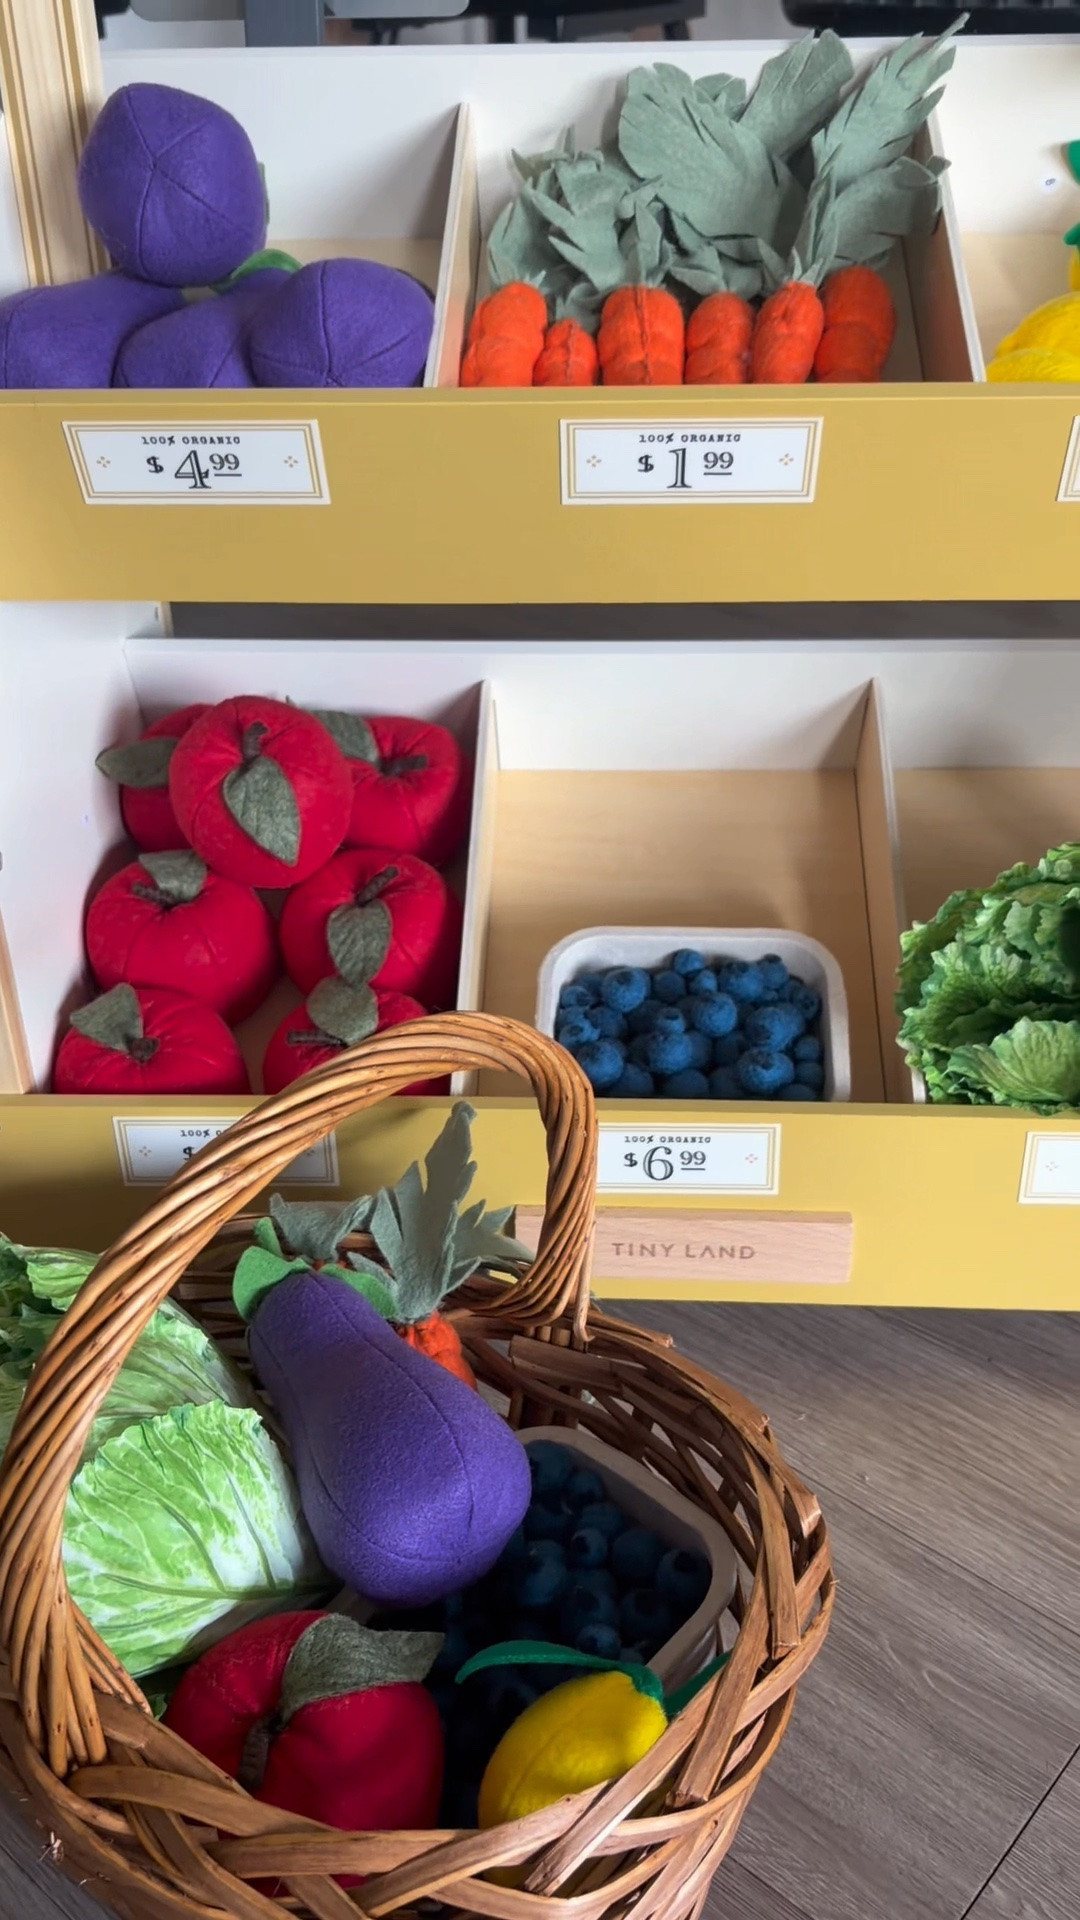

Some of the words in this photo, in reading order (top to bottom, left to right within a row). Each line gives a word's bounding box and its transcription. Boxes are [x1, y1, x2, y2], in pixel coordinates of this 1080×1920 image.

[141, 435, 175, 446] 100%
[181, 436, 241, 445] ORGANIC
[639, 433, 675, 444] 100%
[681, 434, 741, 443] ORGANIC
[624, 1134, 654, 1144] 100%
[659, 1136, 711, 1144] ORGANIC
[611, 1243, 674, 1257] TINY
[685, 1244, 756, 1259] LAND
